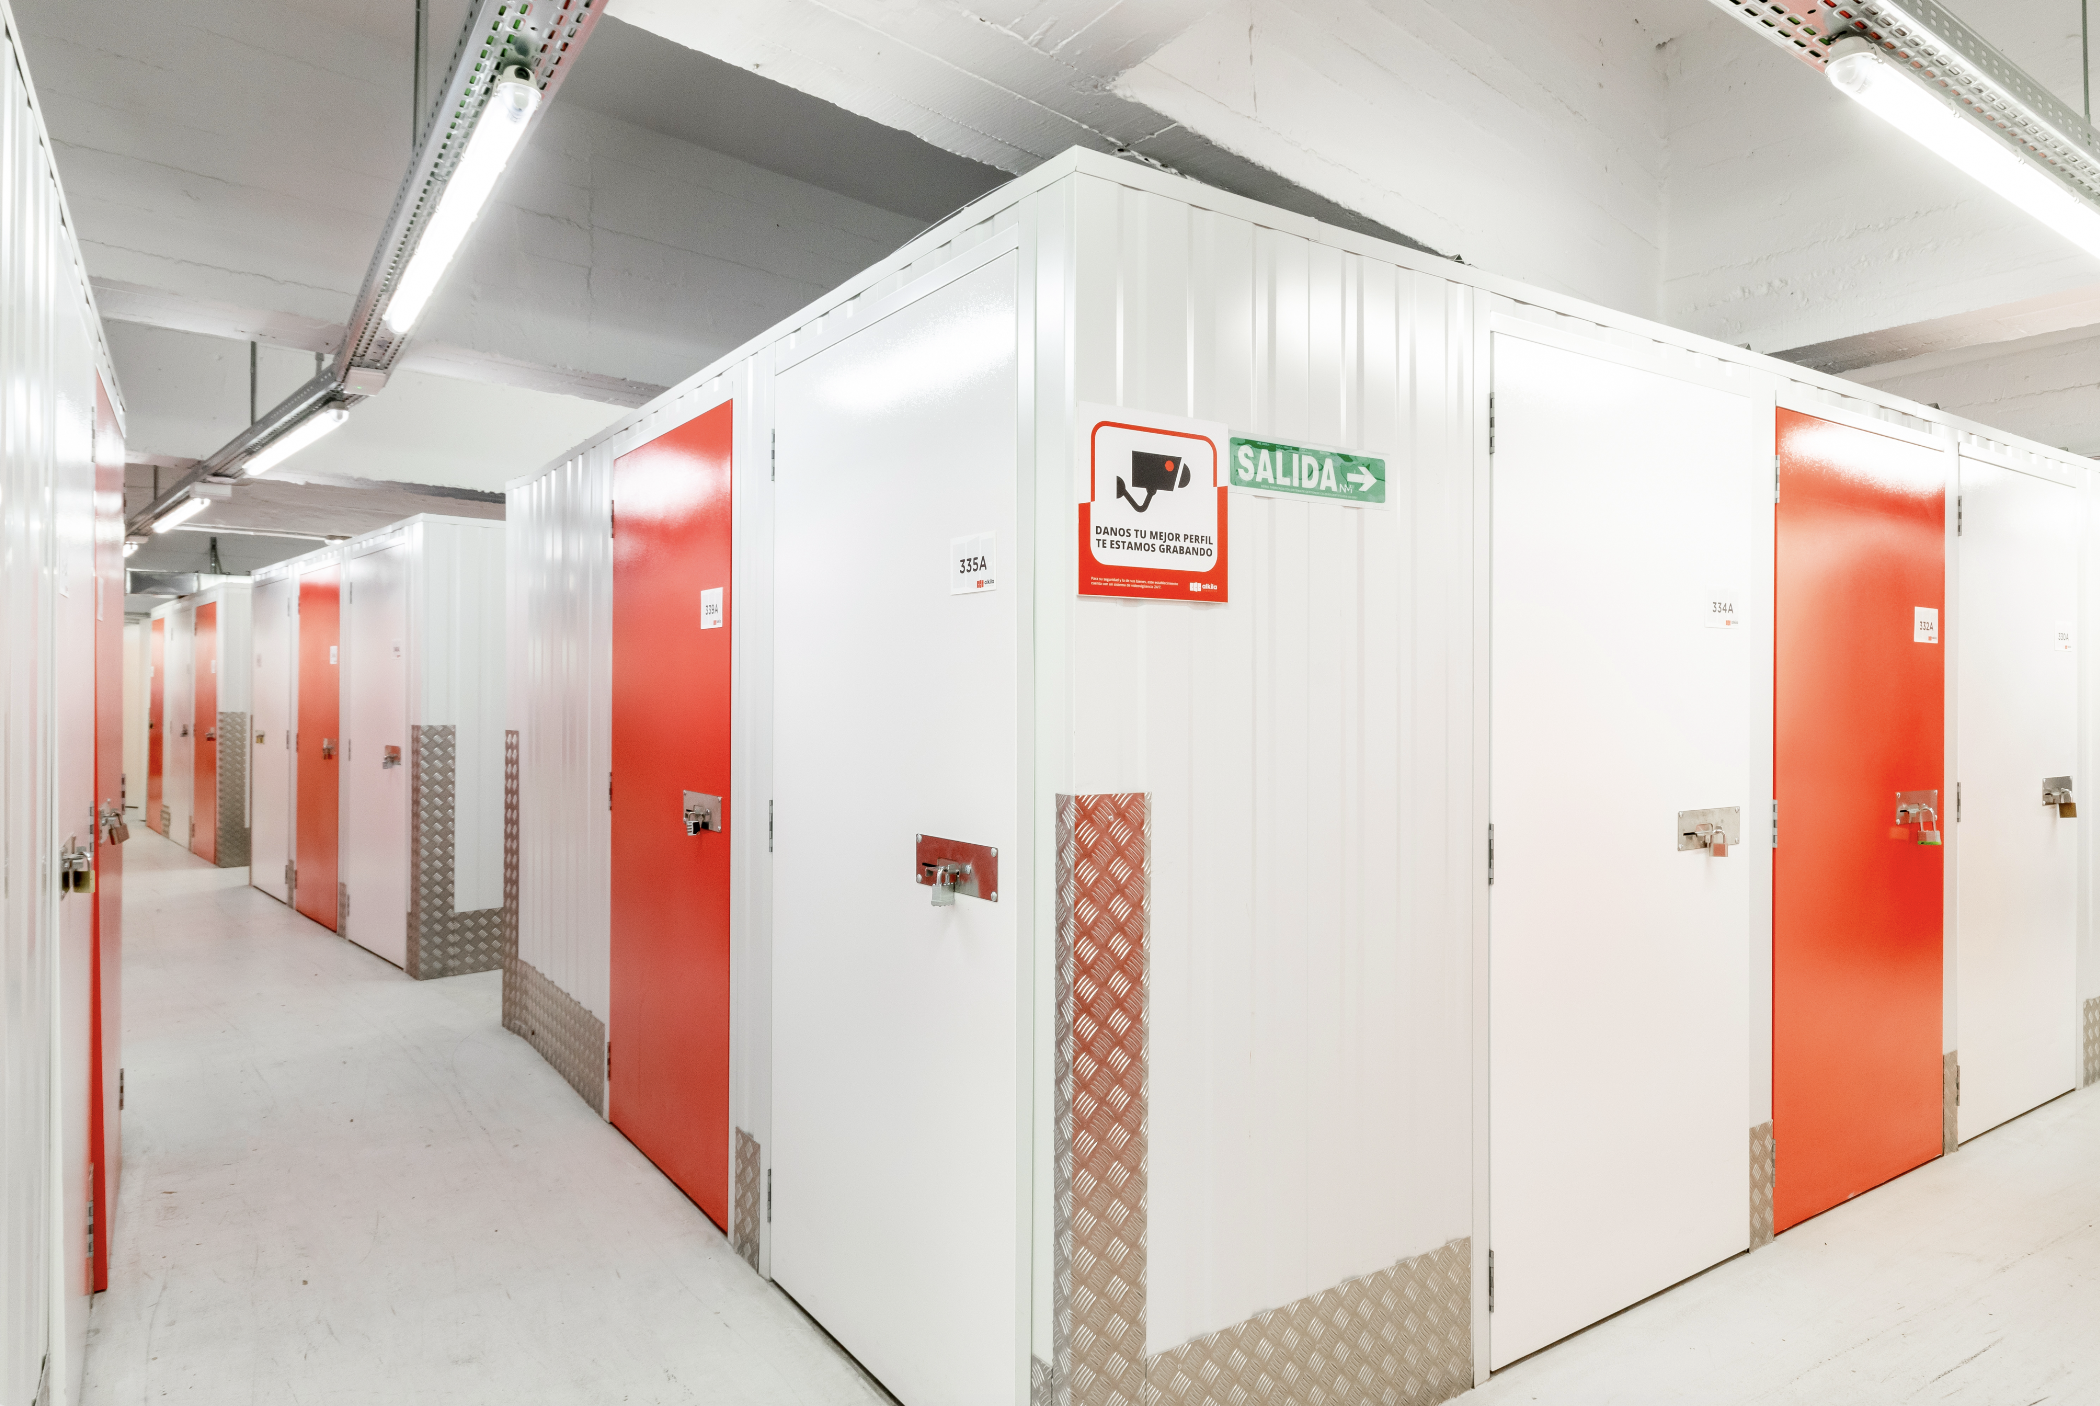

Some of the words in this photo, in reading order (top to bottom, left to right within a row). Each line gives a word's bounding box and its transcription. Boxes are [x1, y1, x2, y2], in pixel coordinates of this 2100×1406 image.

[1237, 444, 1338, 492] SALIDA
[1095, 525, 1132, 538] DANOS
[1133, 529, 1147, 539] TU
[1149, 531, 1181, 543] MEJOR
[1183, 533, 1214, 545] PERFIL
[1095, 538, 1107, 549] TE
[1109, 539, 1156, 553] ESTAMOS
[1158, 543, 1213, 557] GRABANDO
[959, 555, 987, 574] 335A
[1712, 601, 1734, 614] 334A
[1919, 620, 1934, 631] 332A
